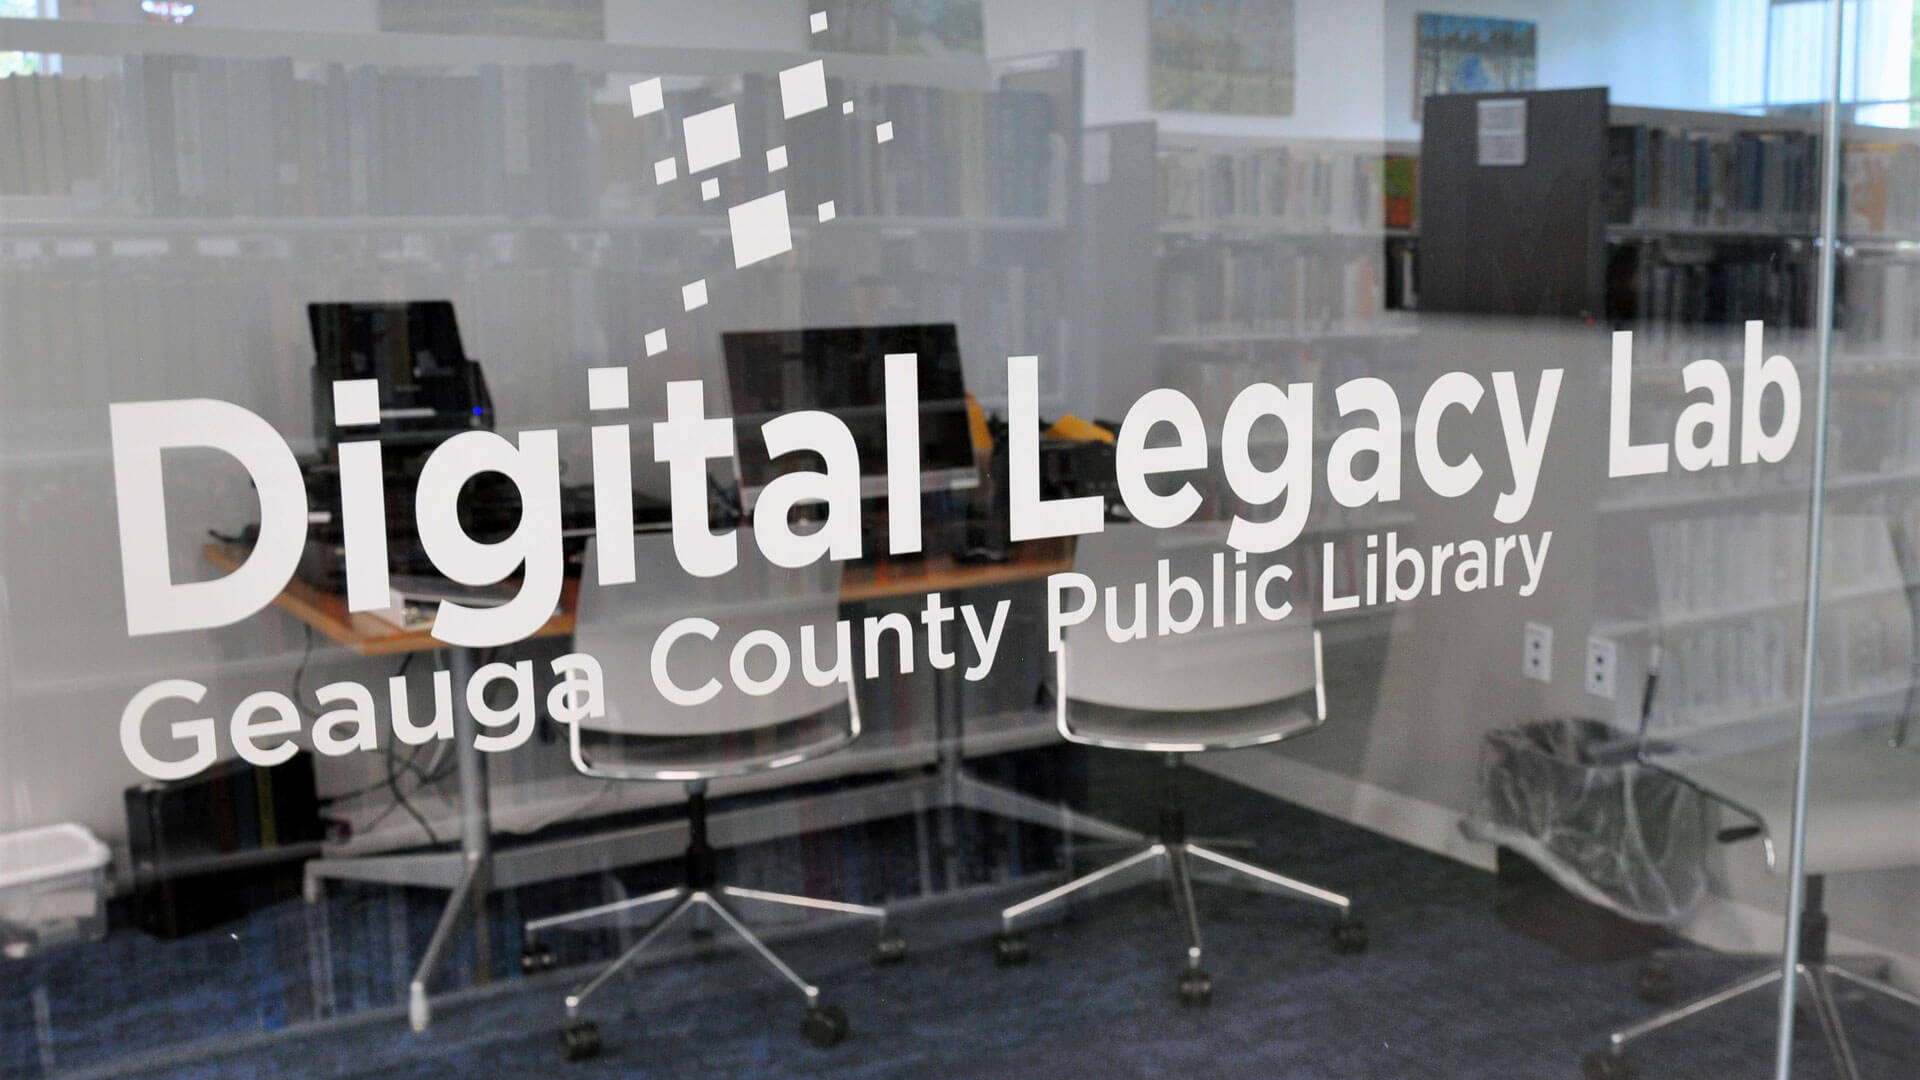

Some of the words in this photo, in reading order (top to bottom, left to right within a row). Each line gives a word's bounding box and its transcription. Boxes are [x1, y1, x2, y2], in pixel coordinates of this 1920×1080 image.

[109, 353, 922, 647] Digital
[1007, 355, 1564, 554] Legacy
[1609, 320, 1802, 478] Lab
[120, 652, 606, 779] Geauga
[650, 592, 1012, 706] County
[1047, 551, 1293, 652] Public
[1322, 530, 1553, 612] Library
